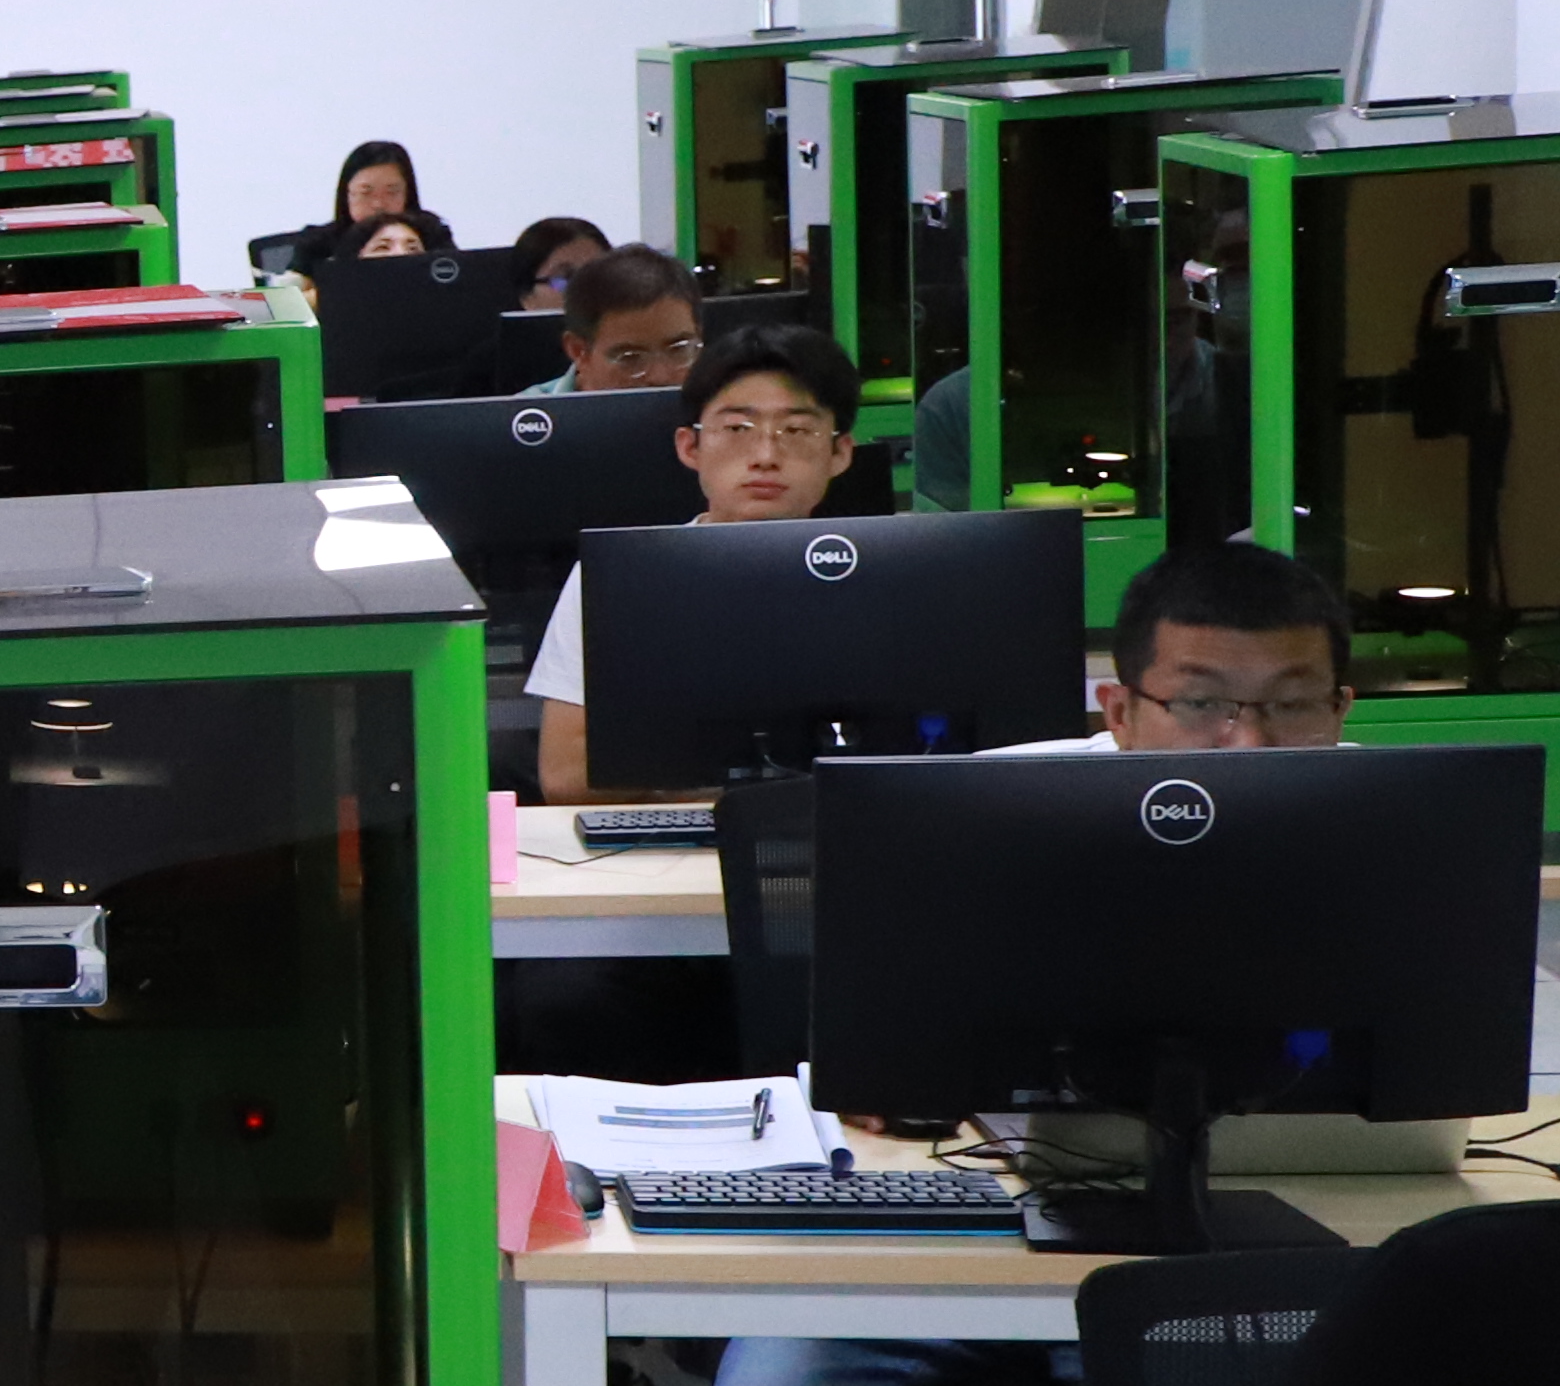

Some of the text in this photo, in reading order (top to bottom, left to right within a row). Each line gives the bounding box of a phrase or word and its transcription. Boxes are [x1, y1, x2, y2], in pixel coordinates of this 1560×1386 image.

[518, 421, 547, 432] DELL
[812, 550, 852, 564] DELL
[1151, 803, 1207, 821] DELL
